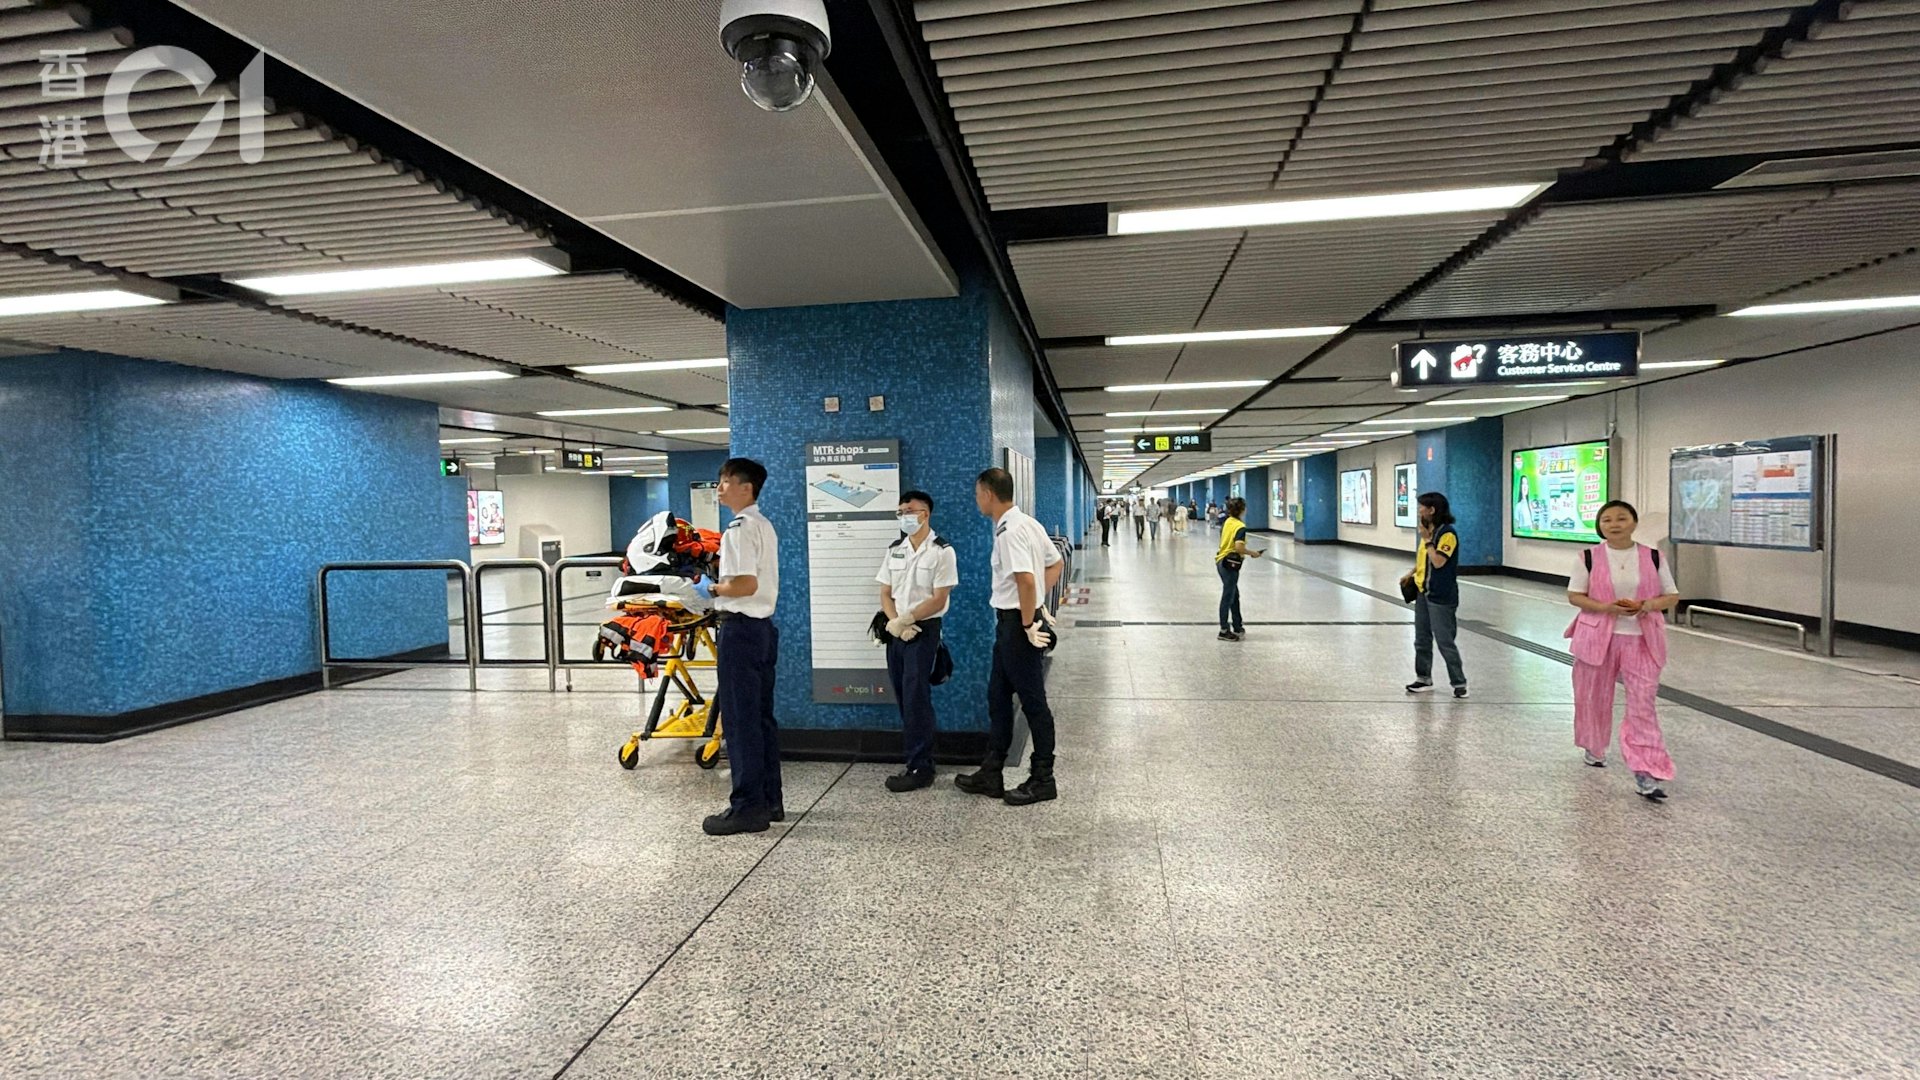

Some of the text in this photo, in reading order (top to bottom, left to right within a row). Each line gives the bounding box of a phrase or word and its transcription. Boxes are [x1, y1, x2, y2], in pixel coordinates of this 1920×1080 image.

[1498, 341, 1583, 364] 客務中心
[1497, 361, 1621, 376] Customer Service Centre
[812, 445, 834, 455] MTR
[835, 444, 864, 456] shops
